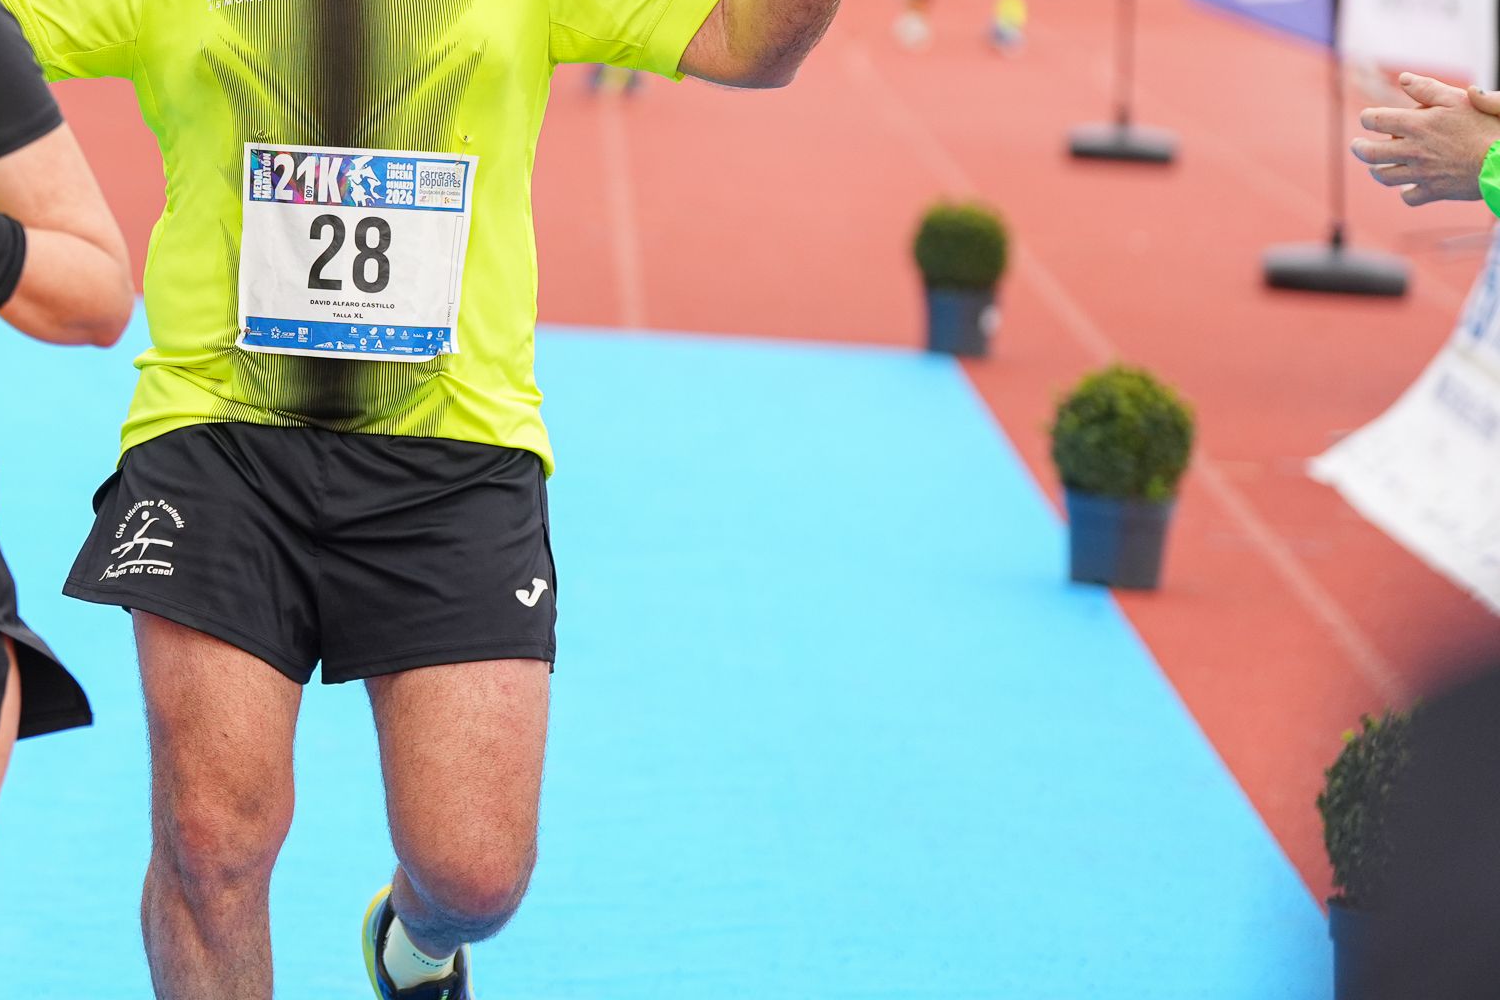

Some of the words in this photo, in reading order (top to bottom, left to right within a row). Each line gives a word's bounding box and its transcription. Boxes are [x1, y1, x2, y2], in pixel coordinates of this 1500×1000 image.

[273, 154, 343, 203] 21K
[419, 177, 461, 189] populares
[420, 170, 456, 180] carreras
[385, 189, 414, 205] 2026
[308, 214, 391, 293] 28
[115, 523, 127, 539] Club
[129, 565, 144, 574] del
[146, 566, 174, 576] Canal
